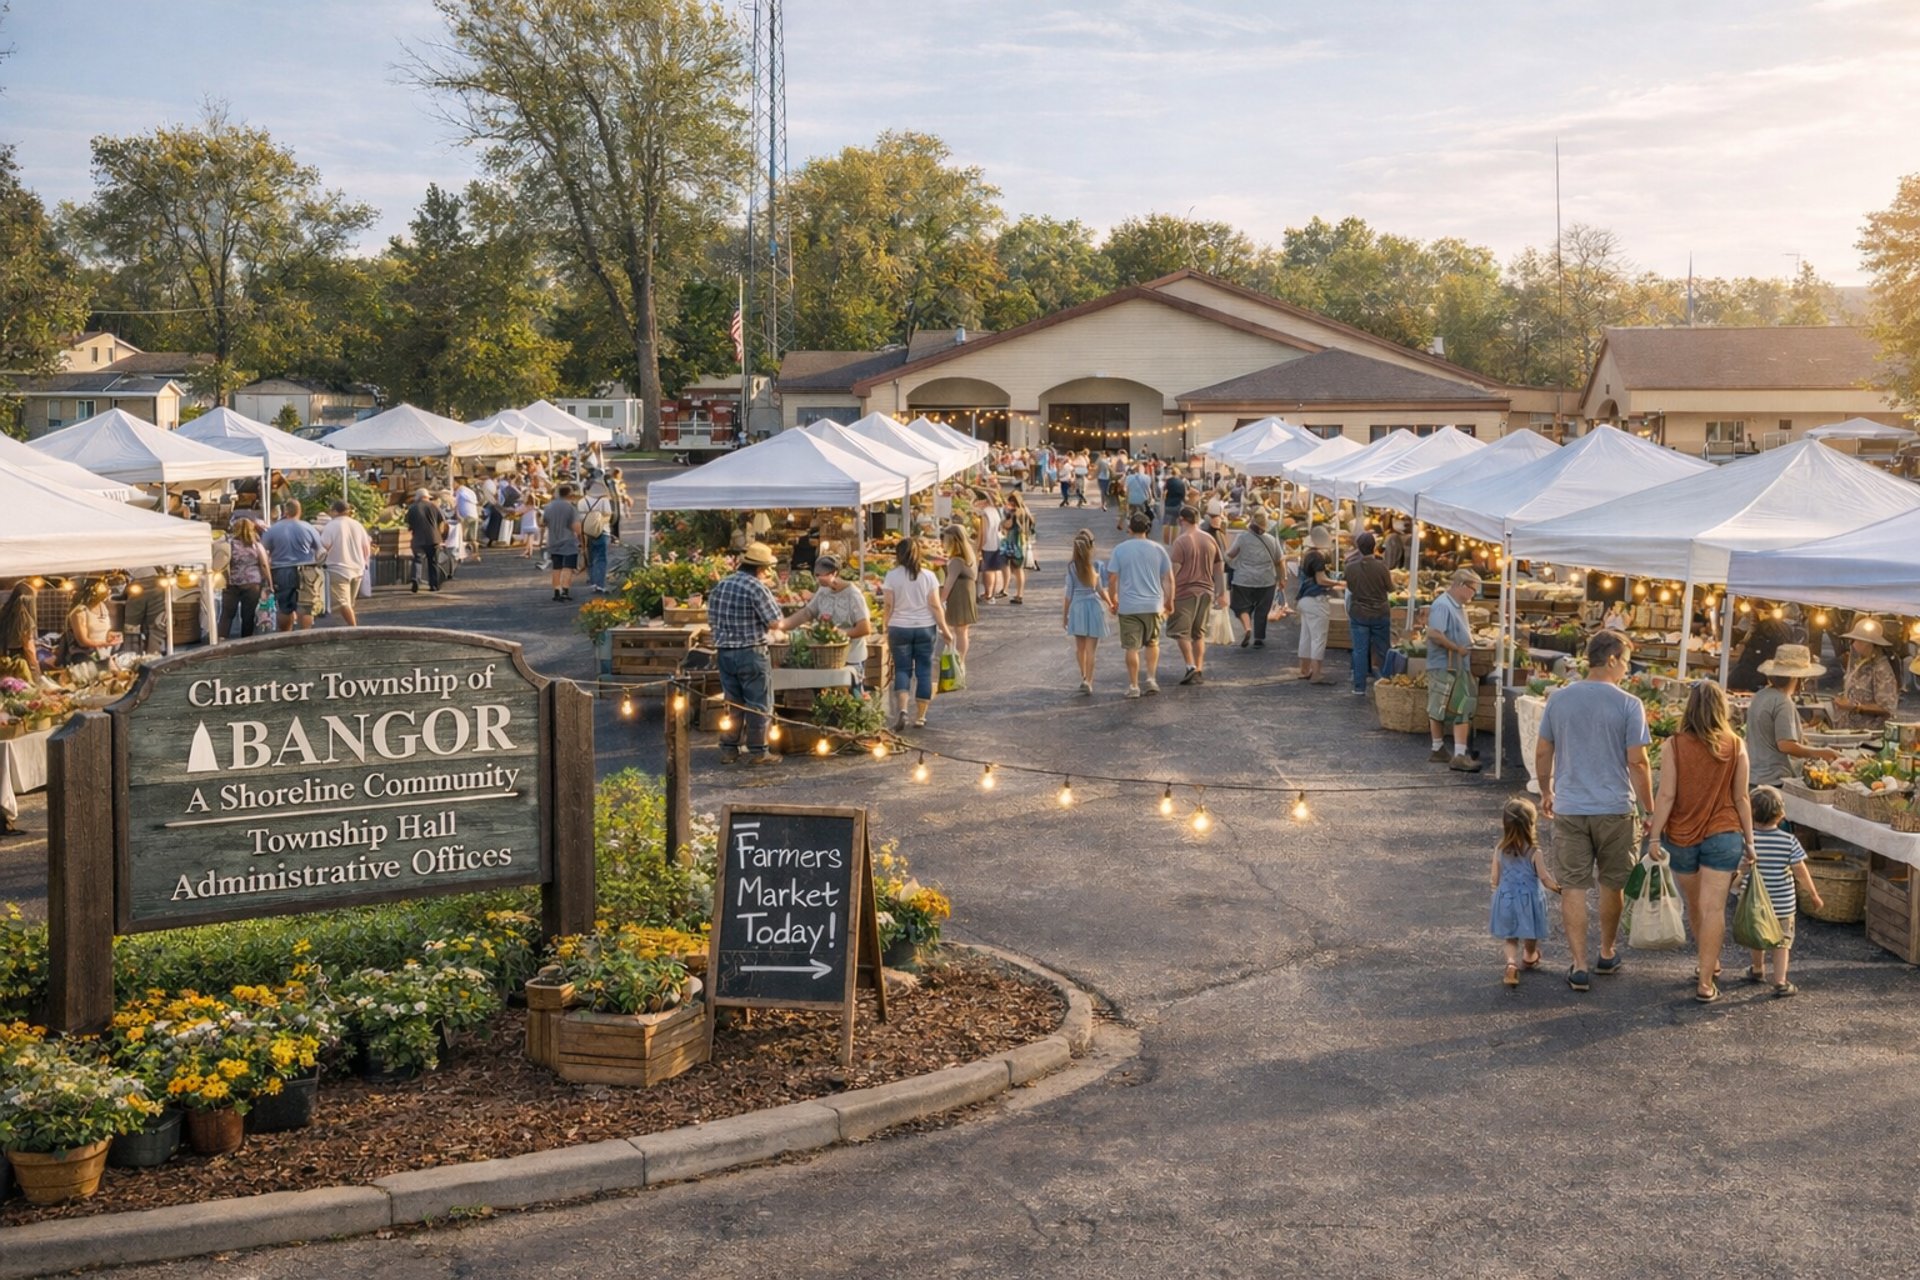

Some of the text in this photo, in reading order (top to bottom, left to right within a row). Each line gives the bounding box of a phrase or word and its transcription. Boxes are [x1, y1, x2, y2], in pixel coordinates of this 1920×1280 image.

[188, 663, 496, 707] Charter Township of
[226, 704, 518, 770] BANGOR
[185, 763, 520, 813] A Shoreline Community
[247, 810, 457, 855] Township Hall
[735, 829, 843, 870] Farmers
[170, 844, 512, 901] Administrative Offices
[737, 875, 840, 908] Market
[736, 911, 837, 955] Today!
